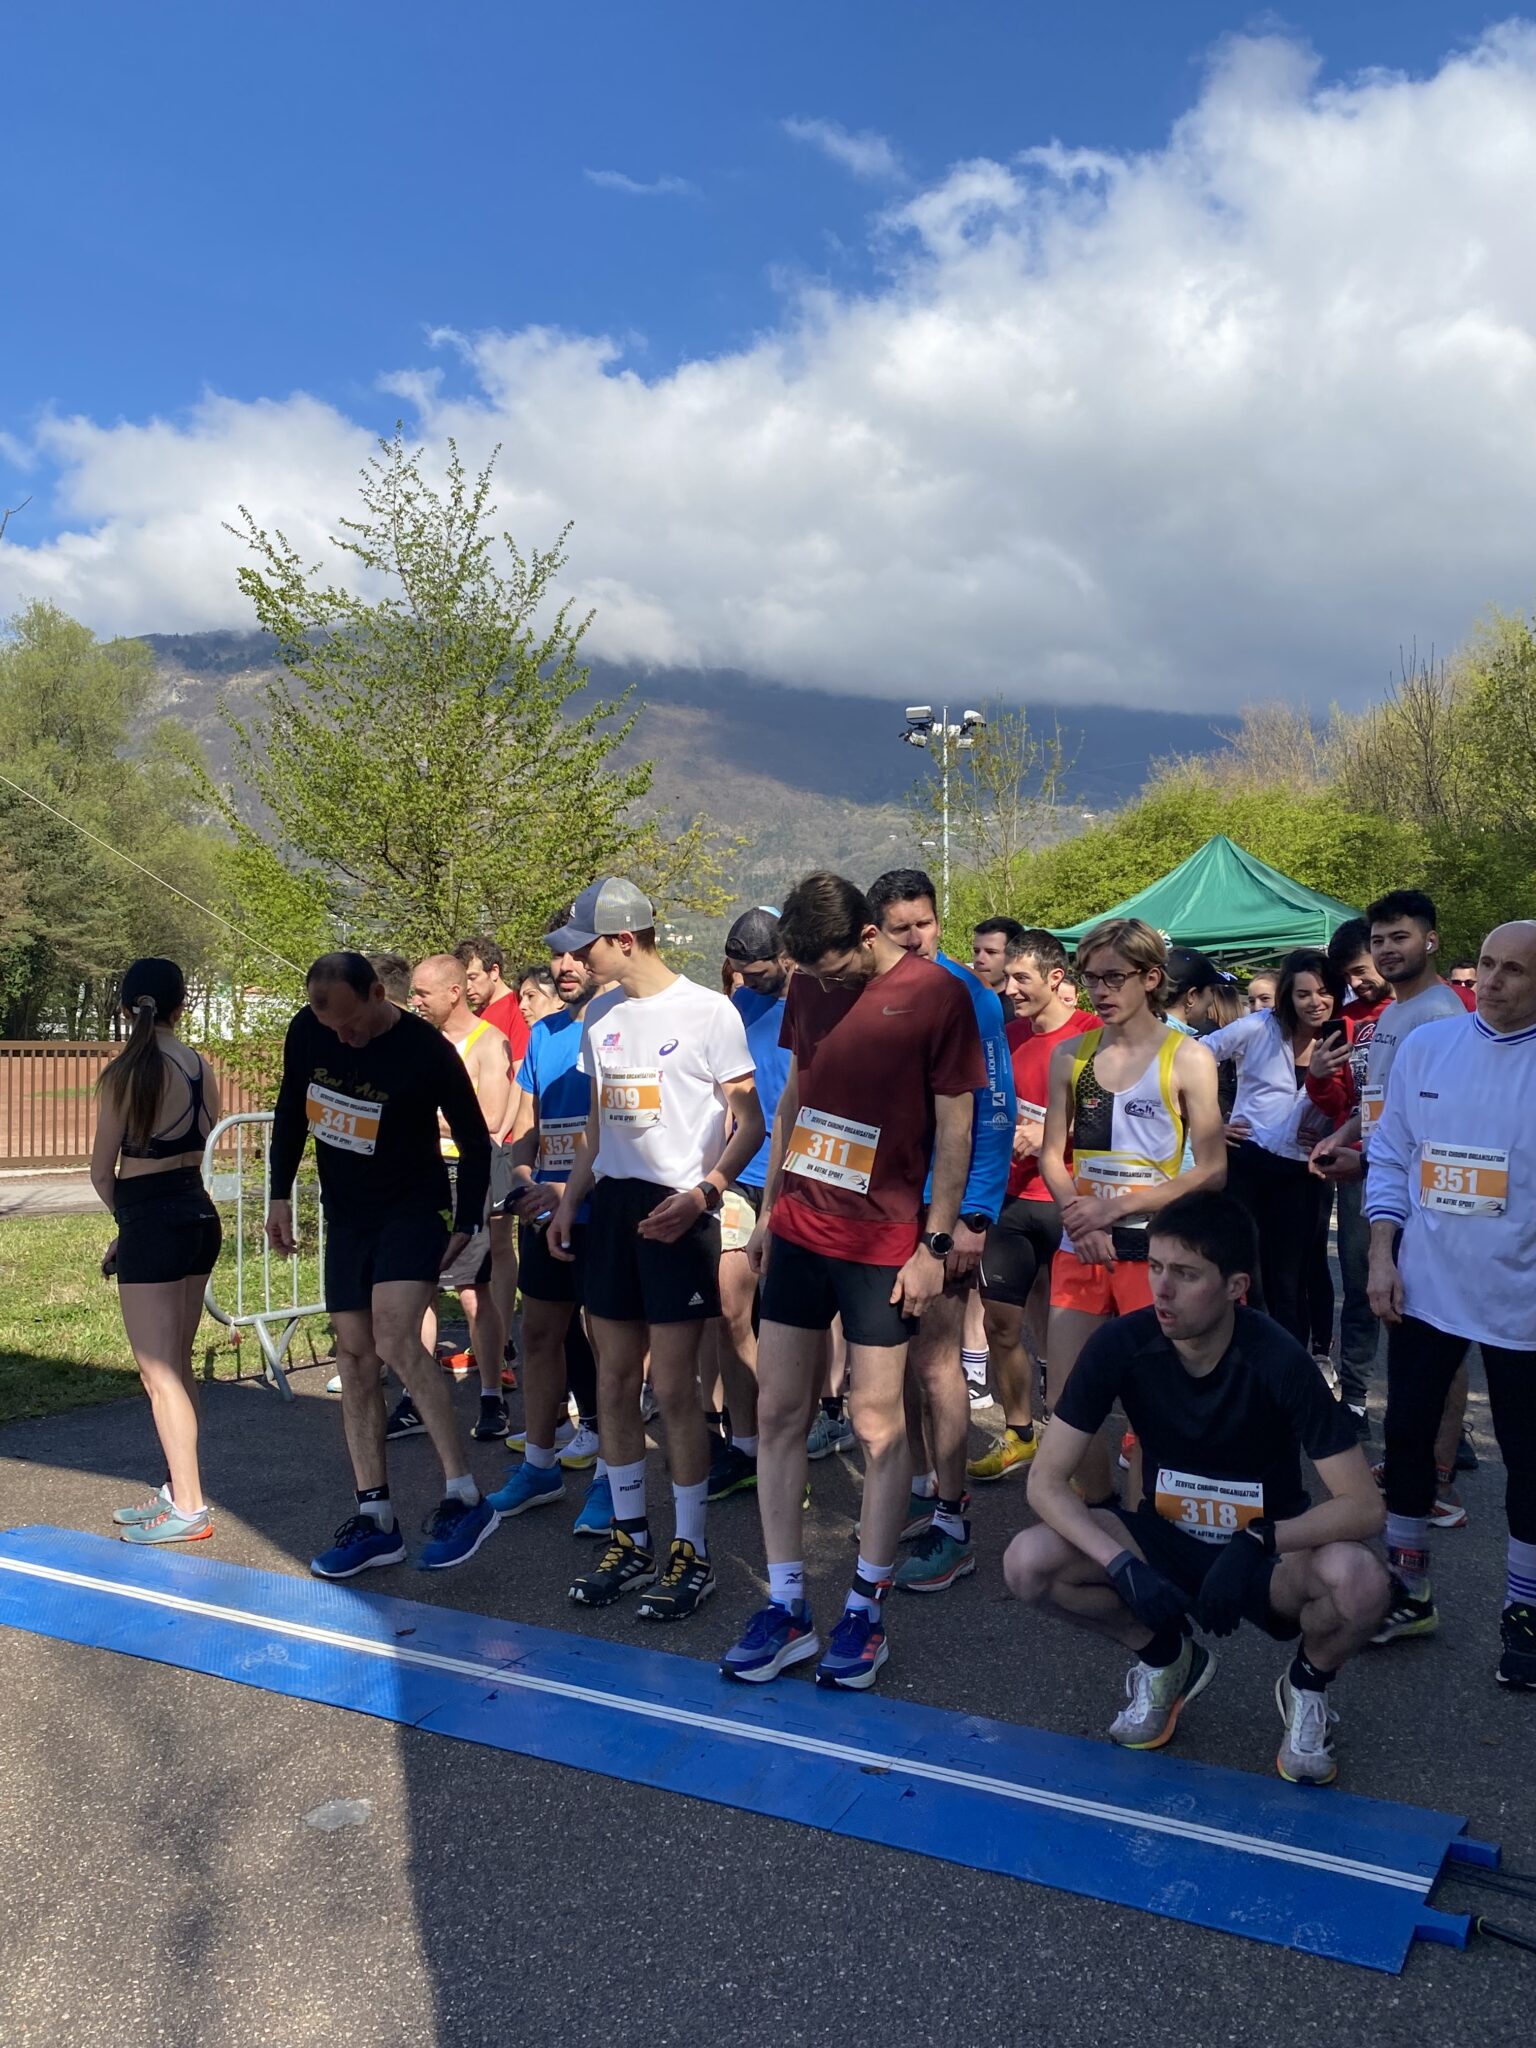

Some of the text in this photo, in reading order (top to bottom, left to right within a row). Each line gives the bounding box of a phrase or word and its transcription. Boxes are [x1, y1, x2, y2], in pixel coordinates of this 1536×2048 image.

[606, 1087, 640, 1109] 309
[320, 1107, 357, 1135] 341
[811, 1116, 876, 1140] SERVICE CHRONO ORGANISATION
[545, 1135, 576, 1154] 352
[807, 1133, 850, 1168] 311
[814, 1165, 827, 1175] AUTRE
[827, 1170, 844, 1180] SPORT
[1433, 1165, 1478, 1194] 351
[1175, 1480, 1259, 1498] SERVICE CHRONO ORGANISATION
[1181, 1498, 1238, 1529] 318
[1216, 1532, 1232, 1540] SPOR
